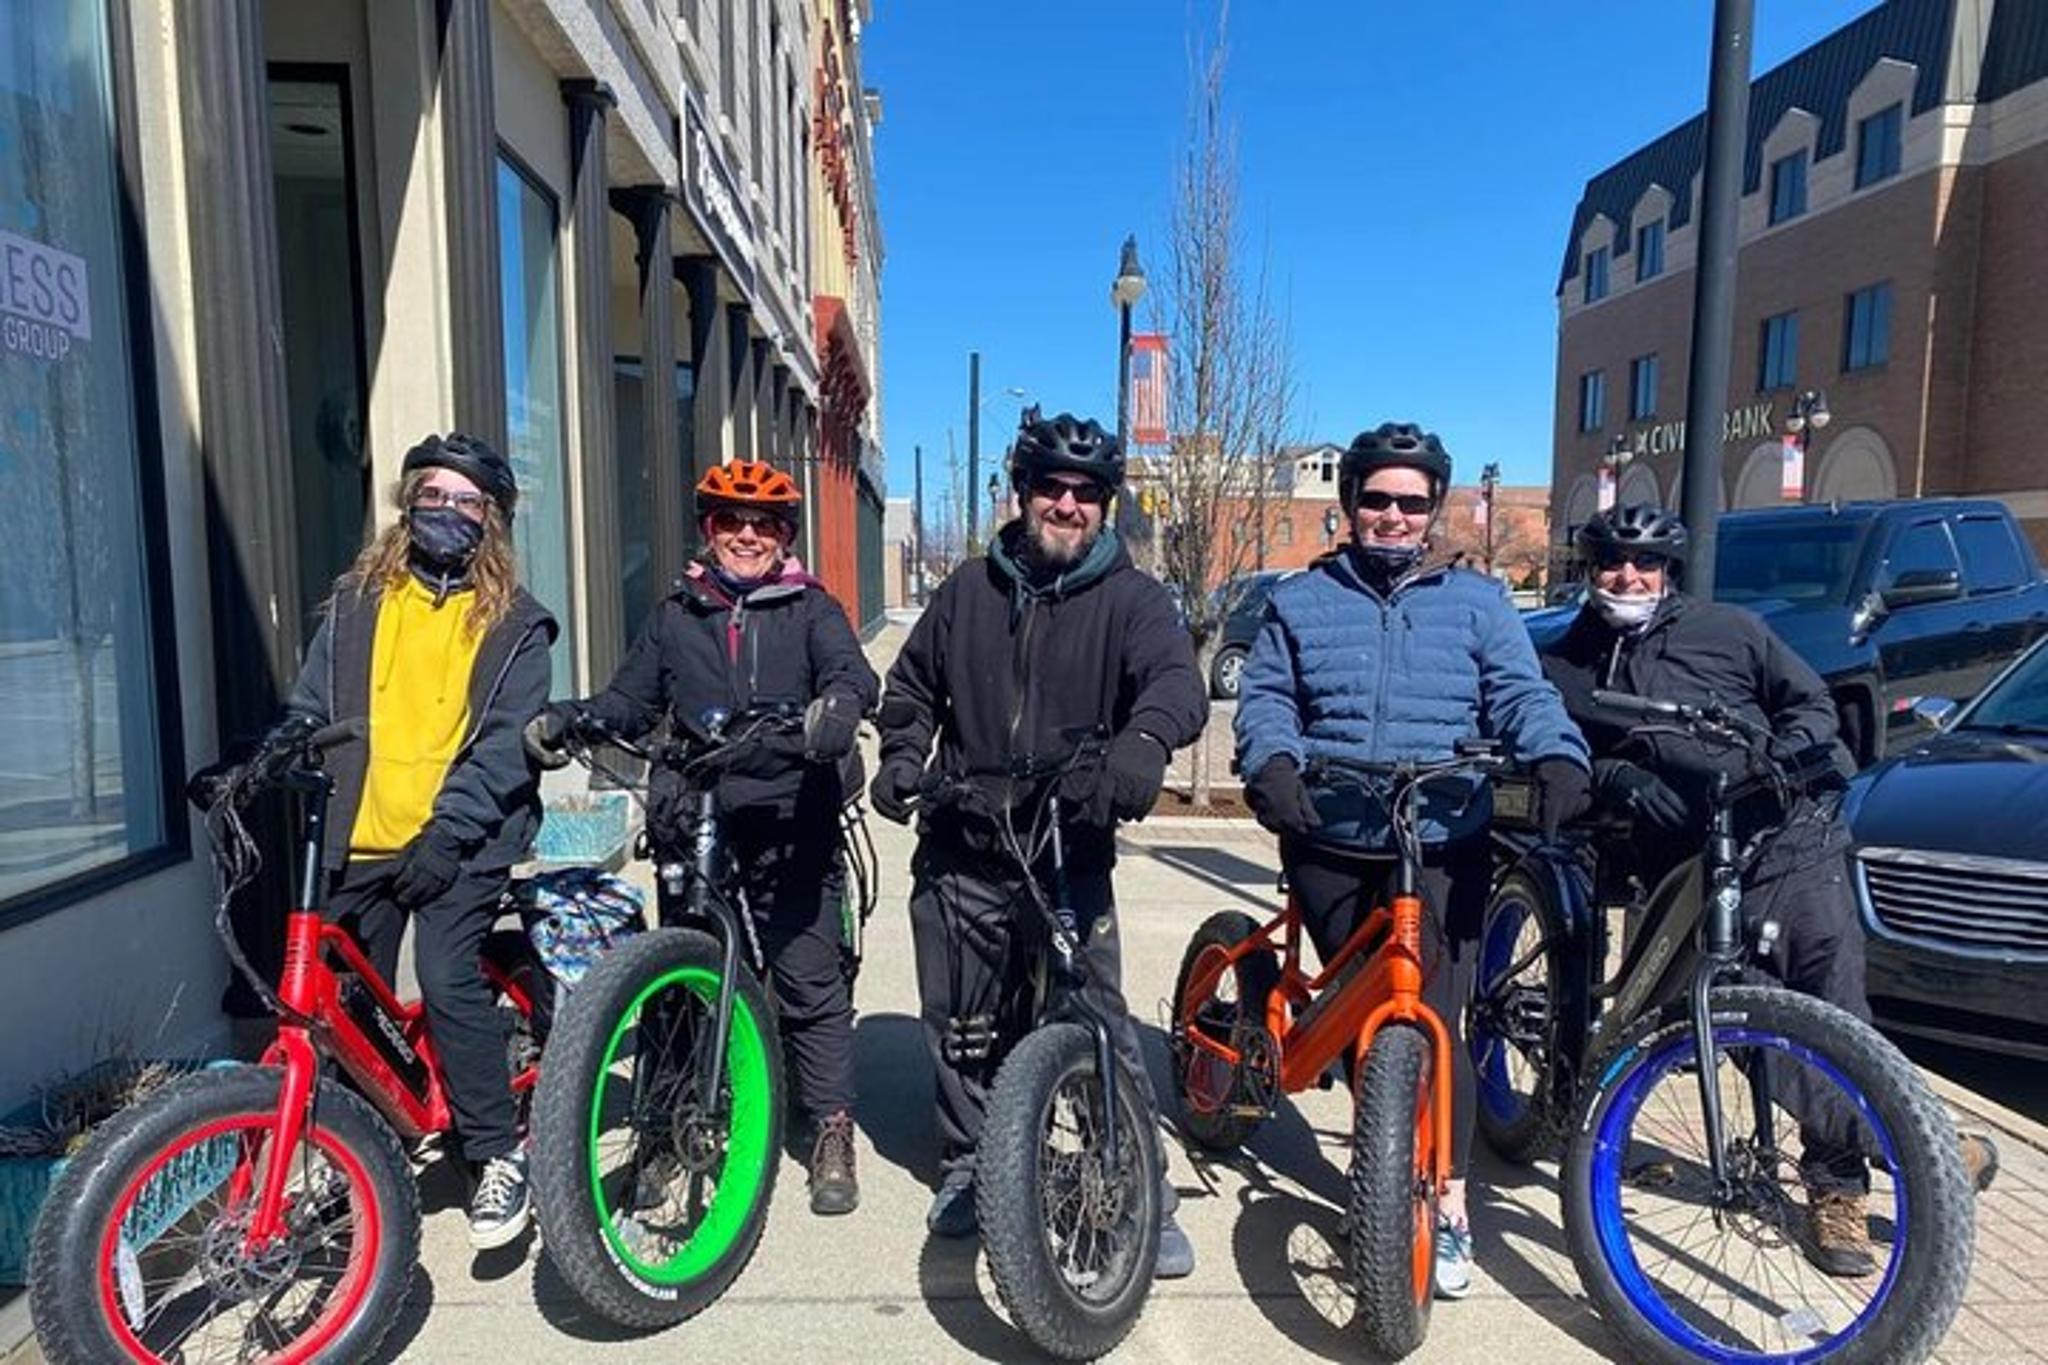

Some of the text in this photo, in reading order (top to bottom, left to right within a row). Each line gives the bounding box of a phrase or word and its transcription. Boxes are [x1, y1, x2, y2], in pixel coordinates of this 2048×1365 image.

[0, 244, 79, 324] ESS
[4, 316, 69, 360] GROUP
[1650, 421, 1685, 455] CIVI
